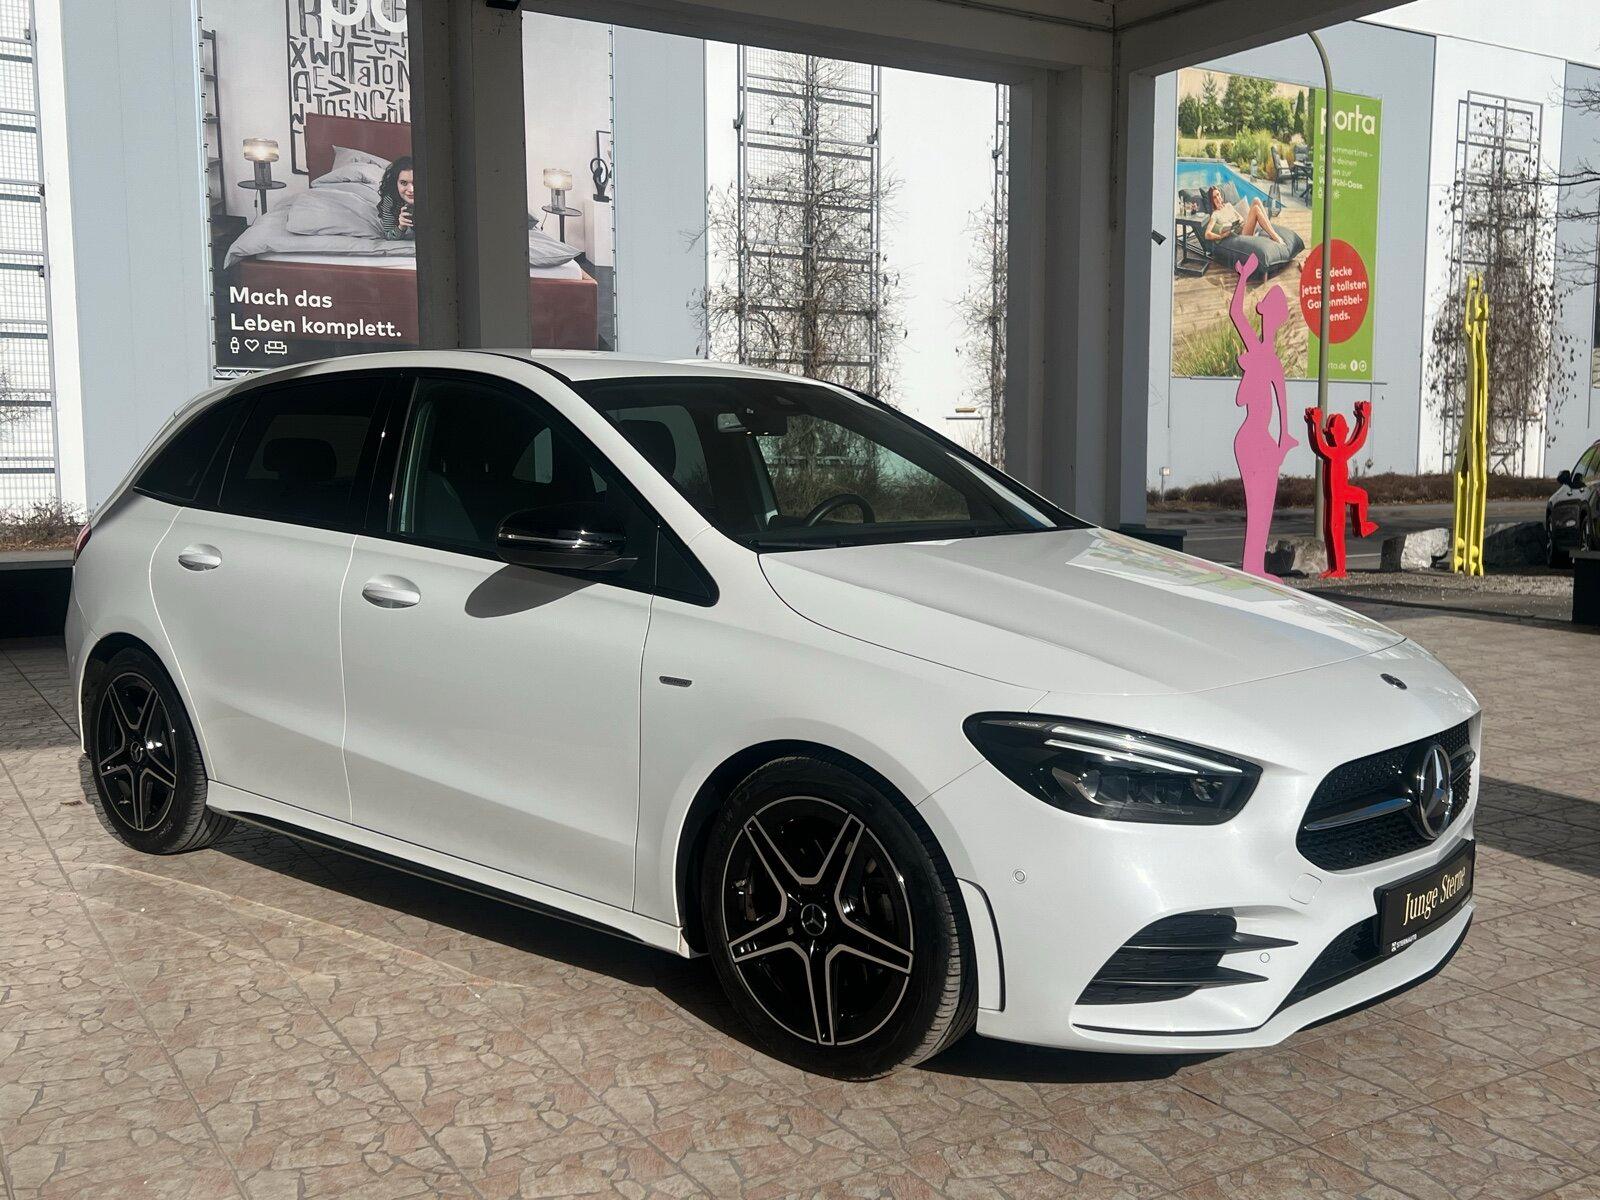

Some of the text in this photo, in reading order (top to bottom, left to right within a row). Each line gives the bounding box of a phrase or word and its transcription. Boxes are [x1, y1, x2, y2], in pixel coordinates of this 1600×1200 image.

[1315, 266, 1353, 279] Edecke
[229, 286, 333, 308] Mach das
[1302, 285, 1322, 297] jetzt
[1336, 280, 1367, 291] tollsten
[1329, 311, 1351, 321] ends.
[230, 313, 402, 339] Leben komplett.
[1402, 866, 1466, 926] Junge Sterne
